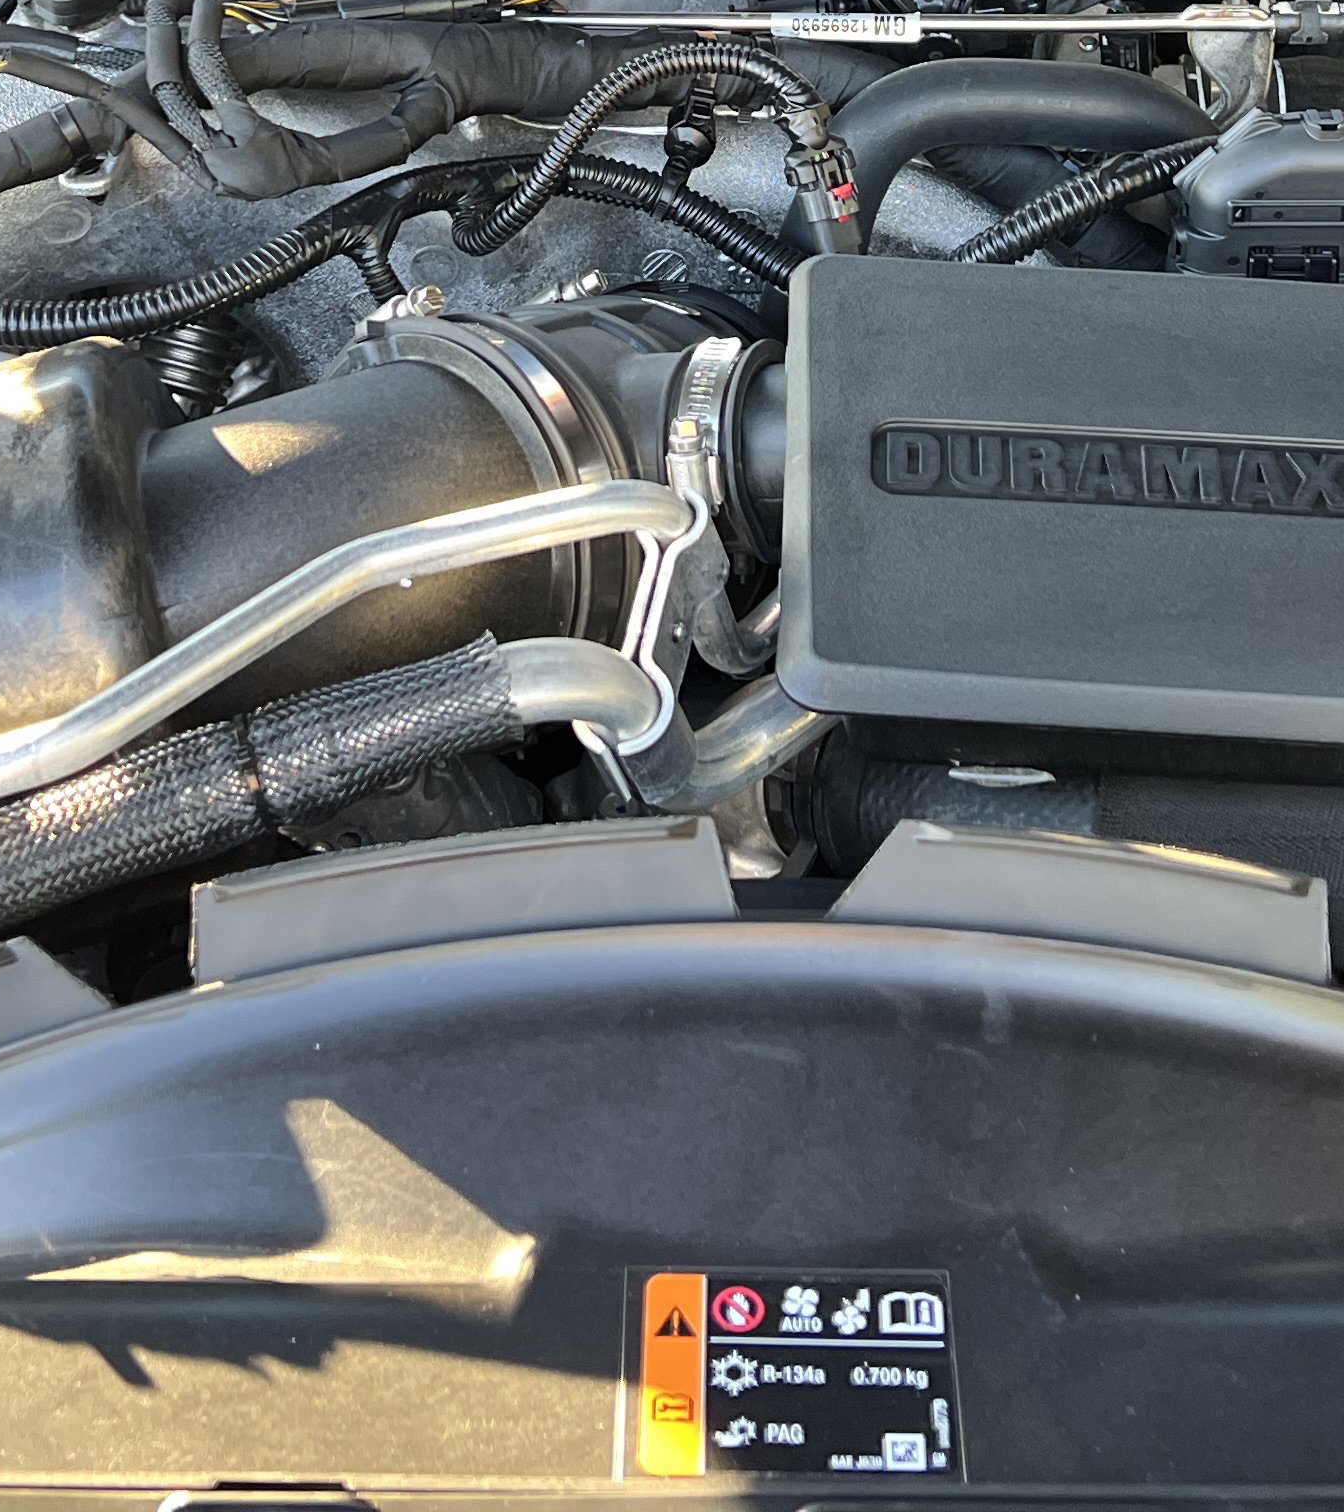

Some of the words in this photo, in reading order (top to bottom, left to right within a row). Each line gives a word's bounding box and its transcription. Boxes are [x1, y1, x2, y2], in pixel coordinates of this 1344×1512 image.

[874, 16, 906, 36] GM
[781, 1316, 822, 1334] AUTO
[761, 1364, 826, 1385] R-134a
[851, 1366, 900, 1386] 0.700
[905, 1367, 929, 1390] kg
[764, 1422, 805, 1445] PAG
